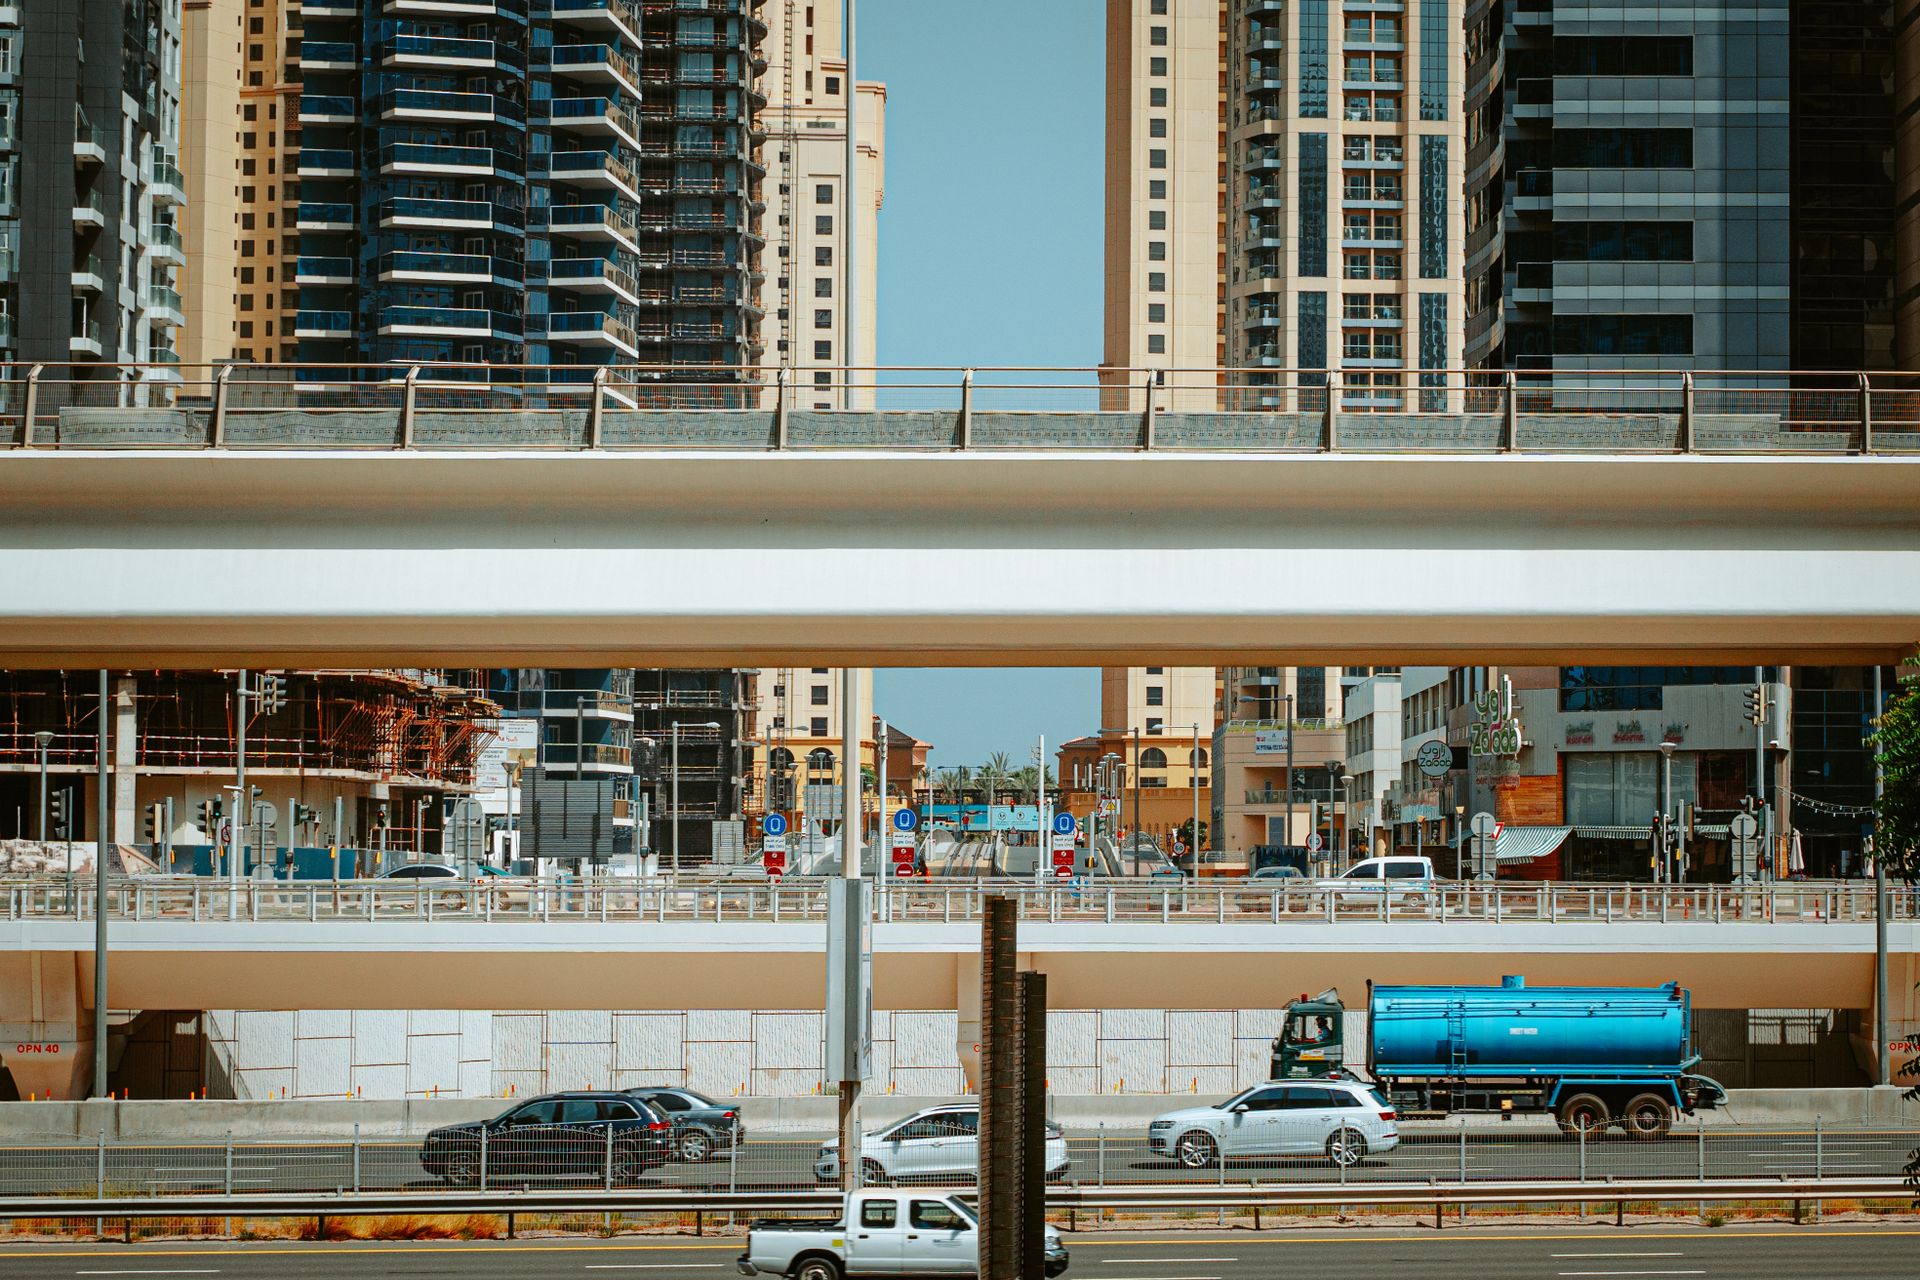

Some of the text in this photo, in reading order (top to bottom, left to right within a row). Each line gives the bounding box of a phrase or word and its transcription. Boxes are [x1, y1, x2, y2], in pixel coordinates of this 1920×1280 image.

[1471, 719, 1520, 756] Zaroob
[1420, 757, 1451, 767] Zaroob
[17, 1044, 59, 1054] OPN 40
